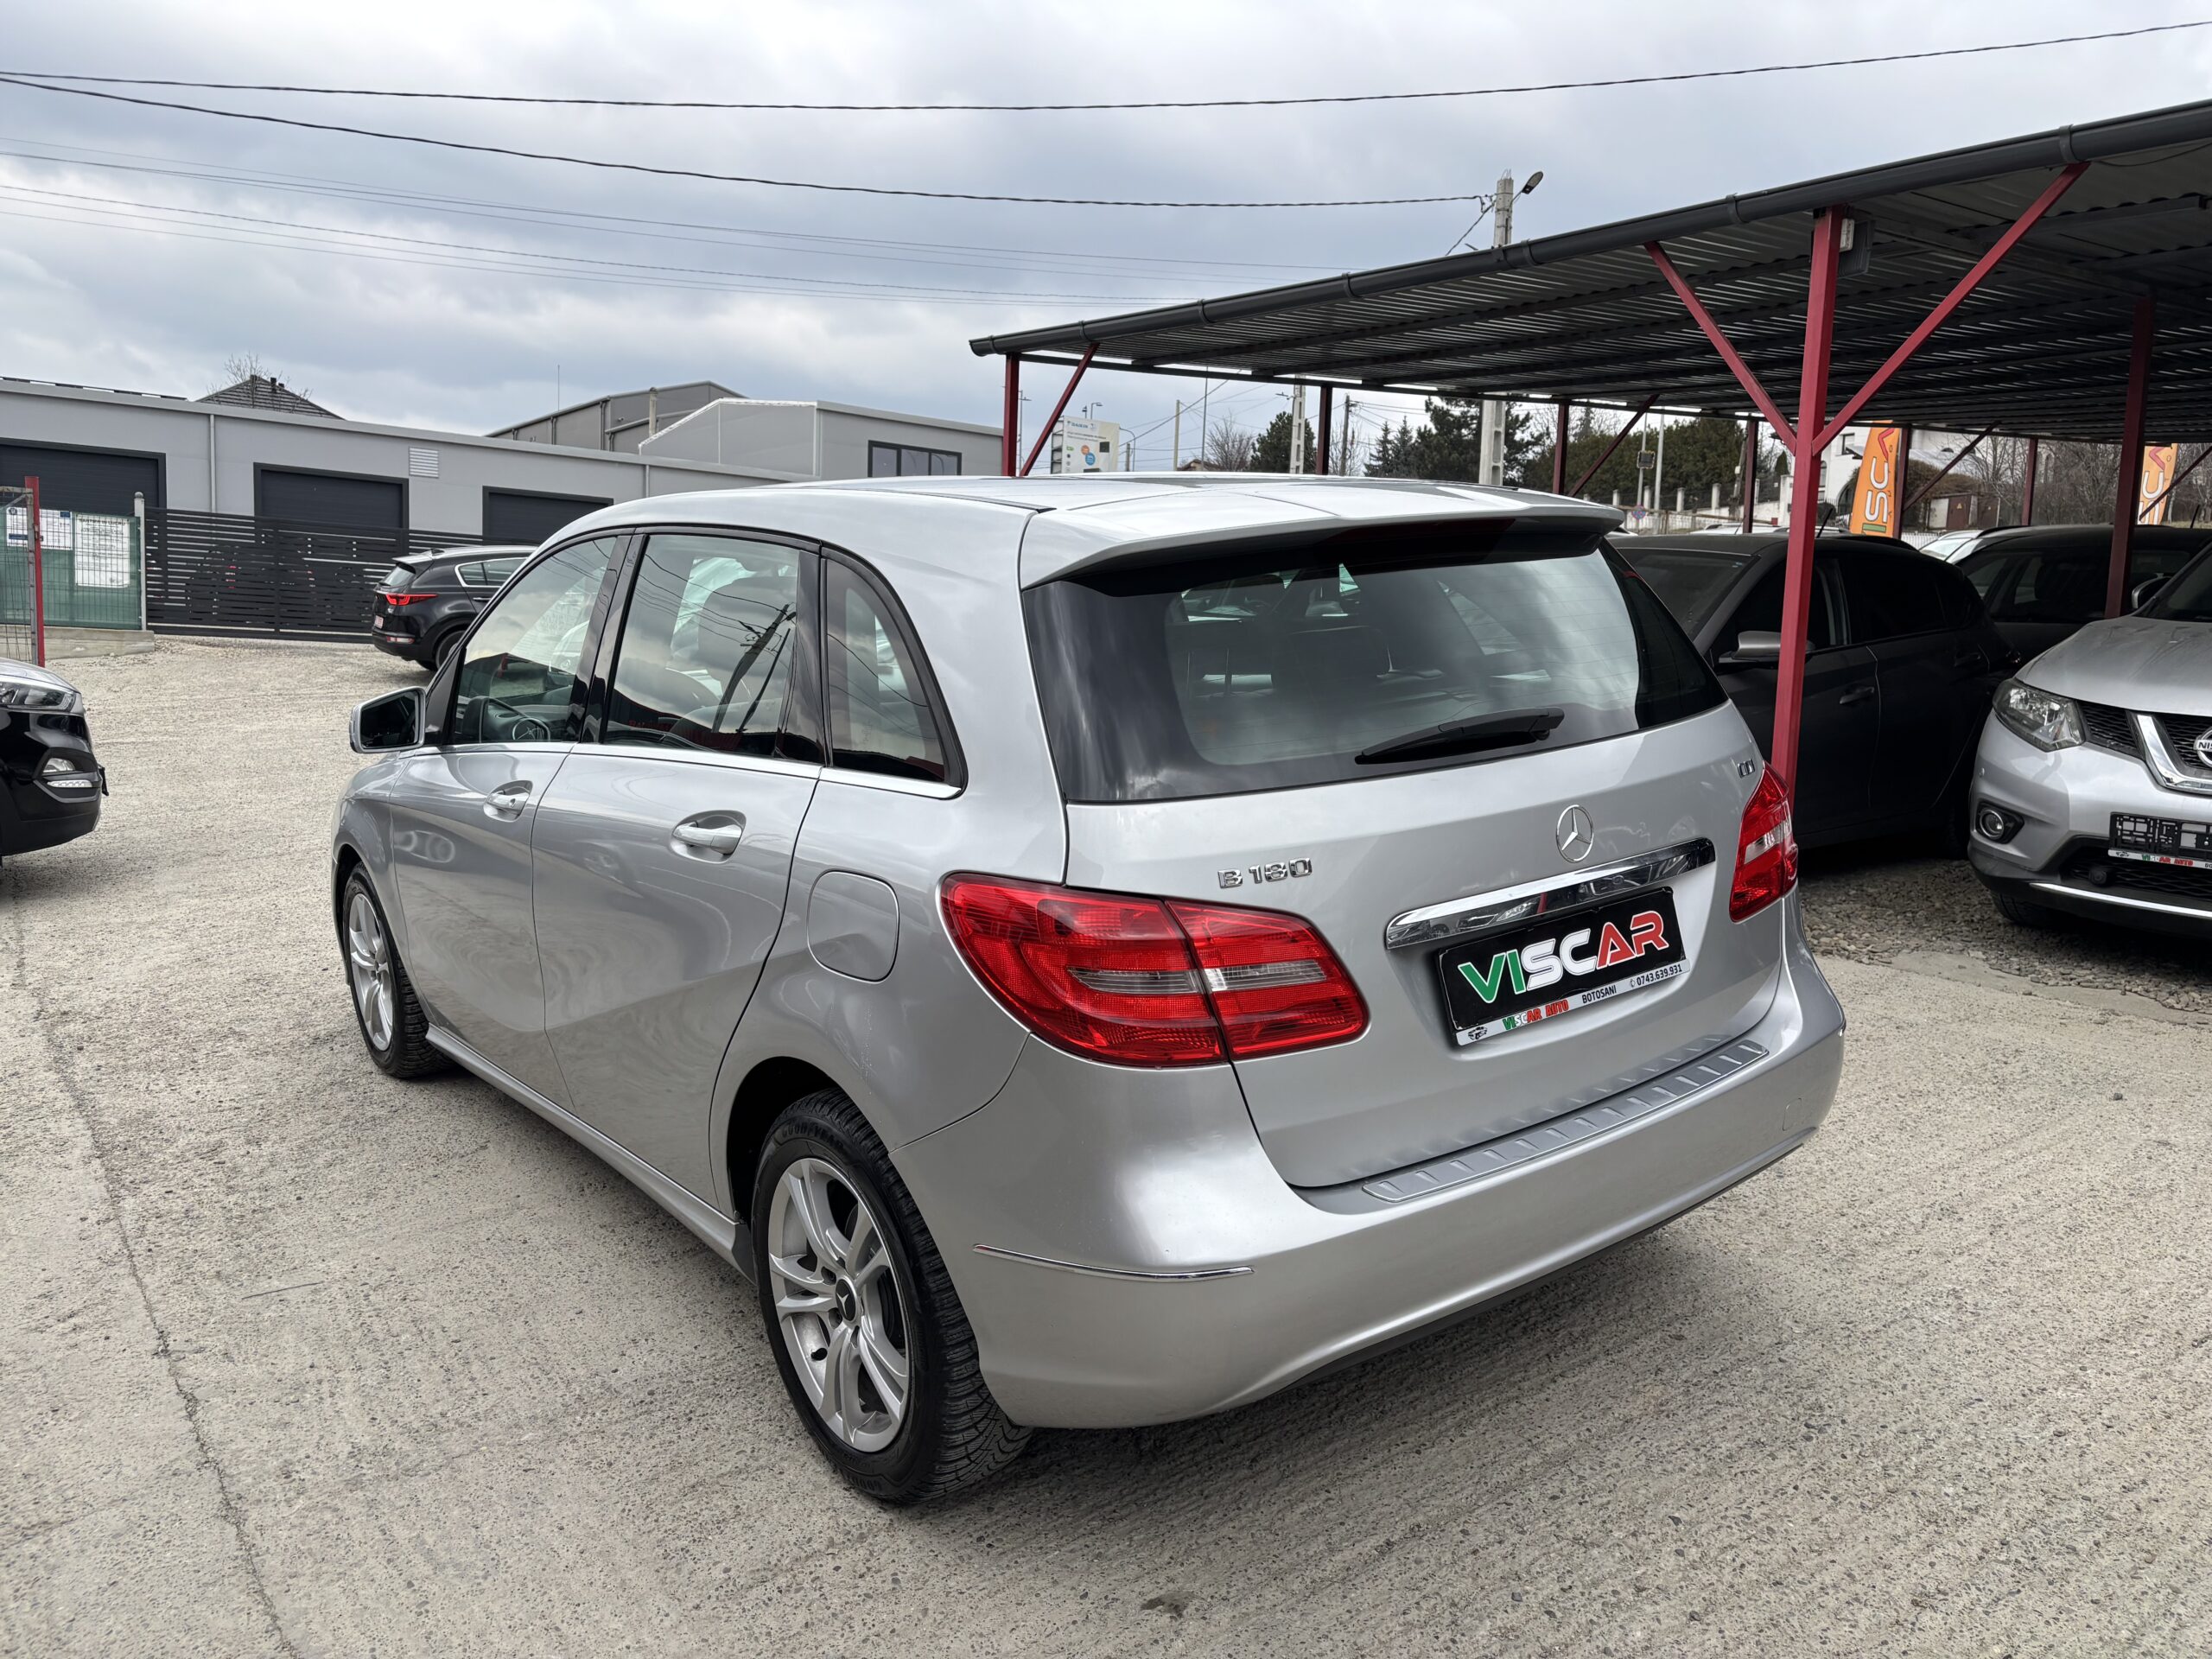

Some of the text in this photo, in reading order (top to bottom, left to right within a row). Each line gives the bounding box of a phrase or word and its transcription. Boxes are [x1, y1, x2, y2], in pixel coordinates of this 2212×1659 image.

[1217, 857, 1313, 889] B 180
[1458, 910, 1669, 1004] VISCAR
[1503, 963, 1683, 1031] VISCAR AUTO BOTOSANI 0743.639.931
